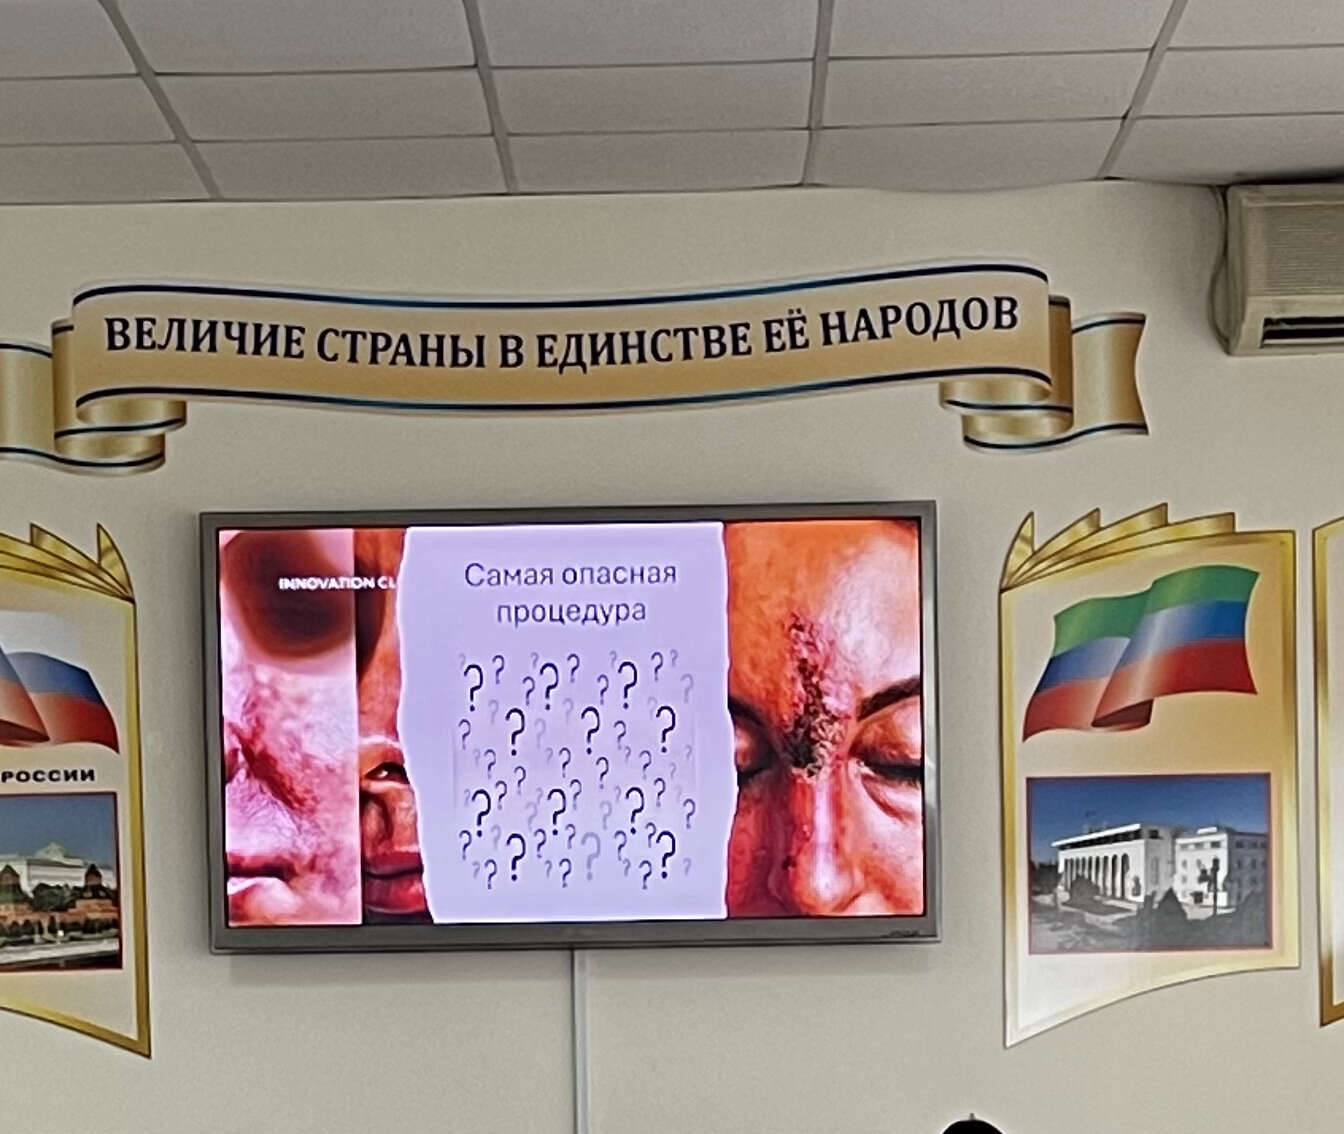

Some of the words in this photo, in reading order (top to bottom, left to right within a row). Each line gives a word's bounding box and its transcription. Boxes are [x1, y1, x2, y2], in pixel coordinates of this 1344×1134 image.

[104, 316, 305, 360] ВЕЛИЧИЕ
[316, 326, 485, 368] СТРАНЫ
[499, 334, 523, 368] В
[535, 322, 752, 375] ЕДИНСТВЕ
[762, 308, 810, 354] ЕЁ
[819, 296, 1020, 347] НАРОДОВ
[278, 577, 375, 590] INNOVATION
[464, 562, 554, 587] Самая
[561, 563, 677, 586] опасная
[496, 600, 647, 628] процедура
[1, 768, 96, 783] РОССИИ
